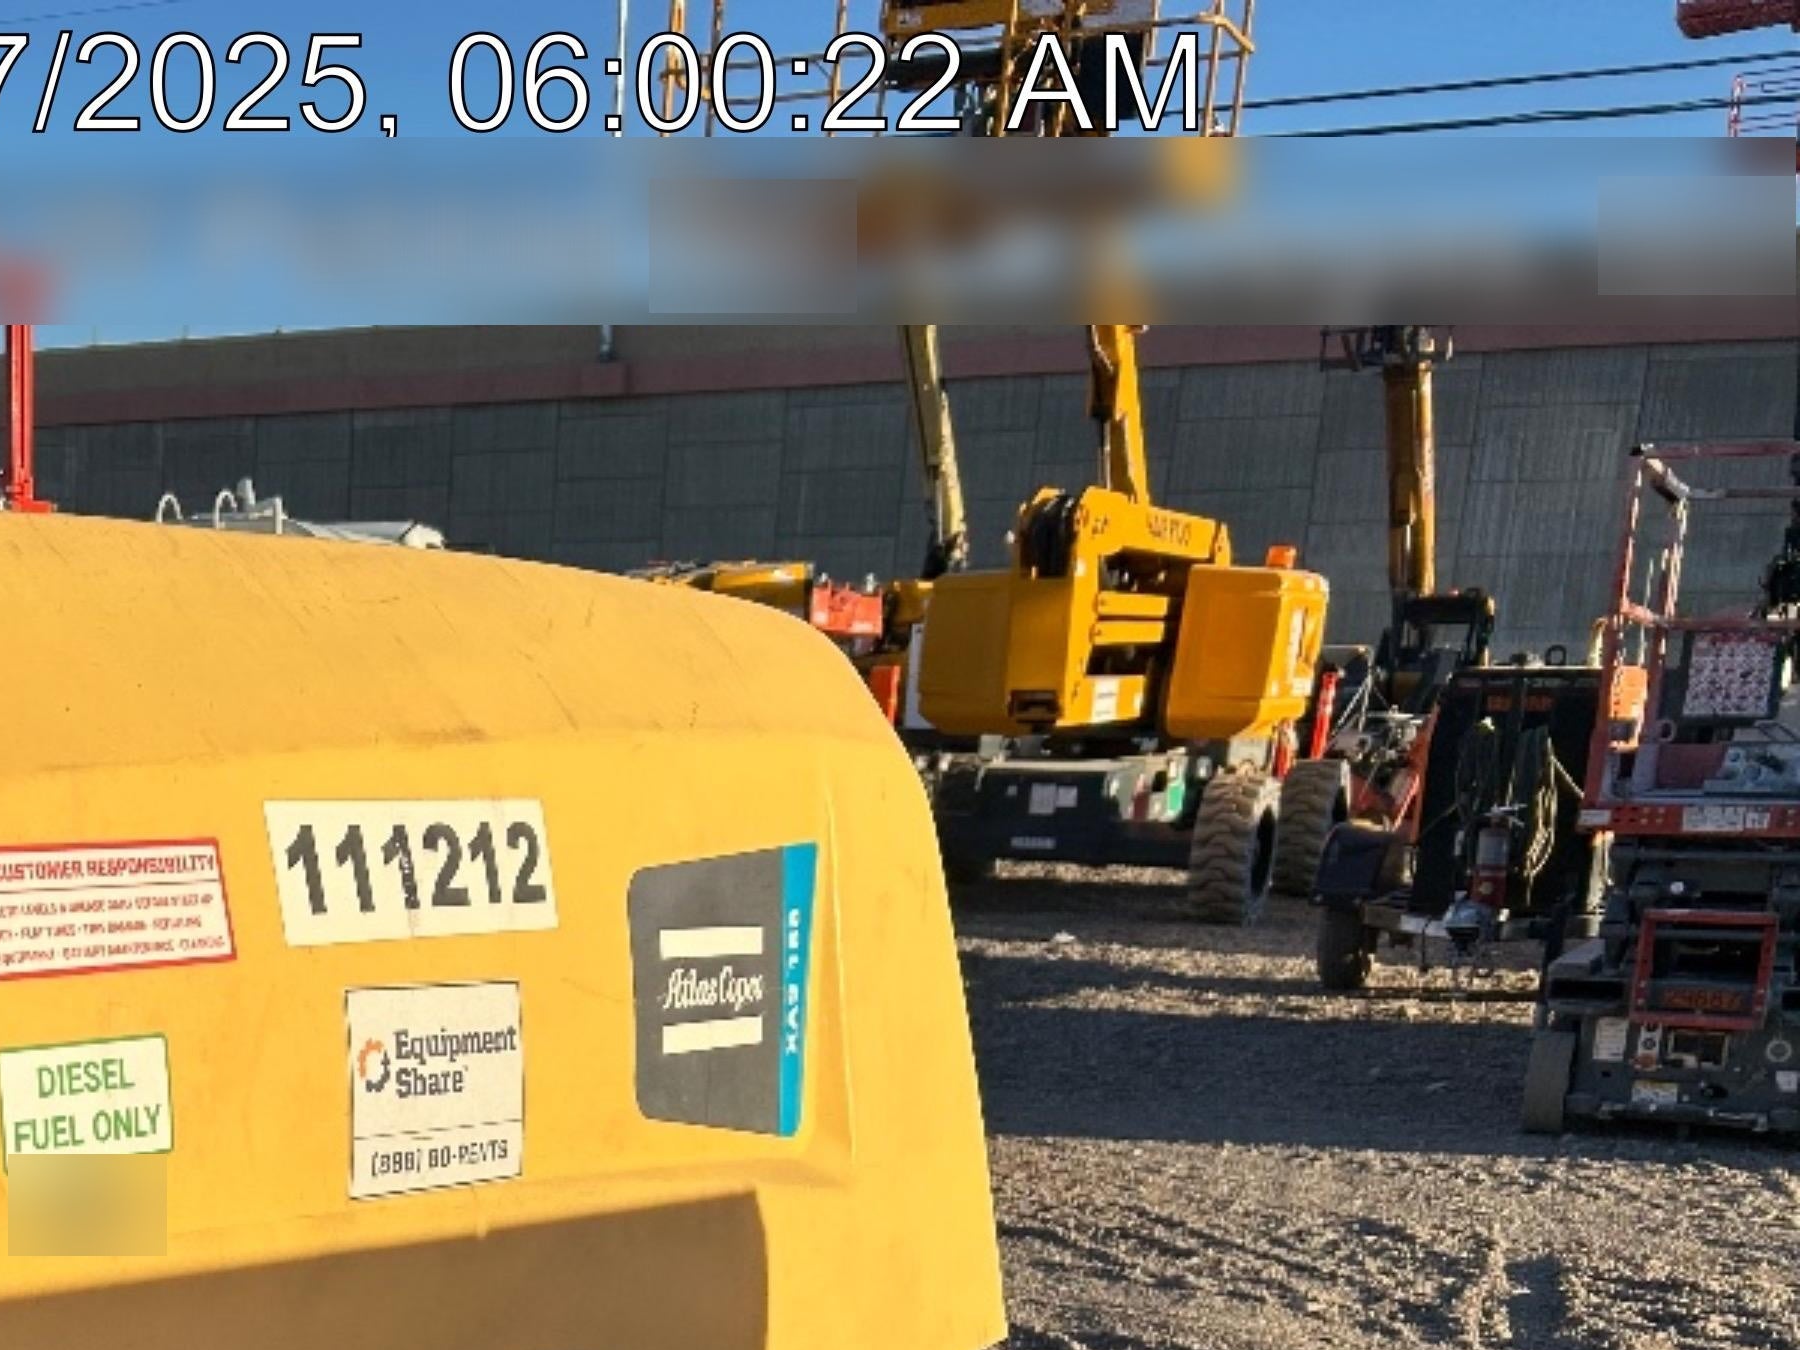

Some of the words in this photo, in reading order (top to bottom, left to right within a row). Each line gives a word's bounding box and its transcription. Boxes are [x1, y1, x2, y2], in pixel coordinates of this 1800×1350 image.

[87, 854, 215, 878] RESPONSIBILITY
[285, 821, 547, 915] 111212
[662, 968, 718, 1009] Atlas
[393, 1025, 517, 1066] Equipment
[37, 1058, 136, 1099] DIESEL
[395, 1067, 464, 1099] Share
[13, 1115, 85, 1153] FUEL
[92, 1103, 162, 1142] ONLY
